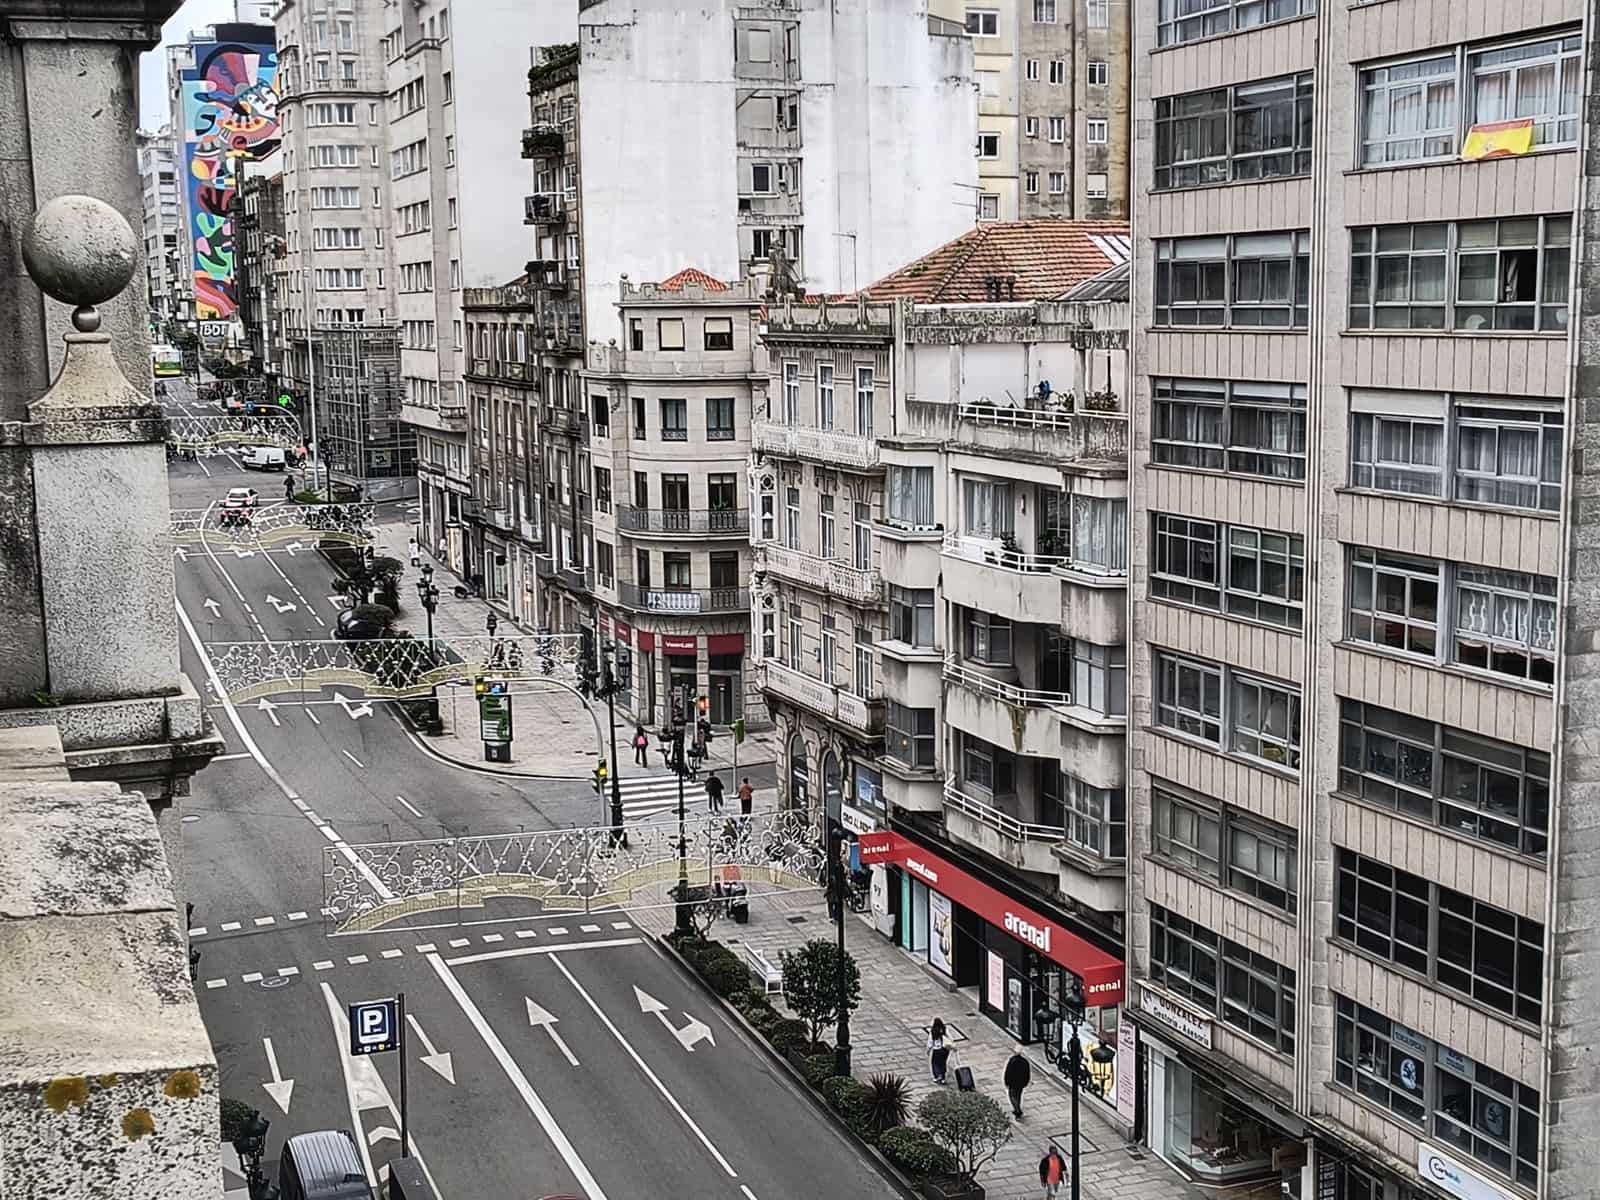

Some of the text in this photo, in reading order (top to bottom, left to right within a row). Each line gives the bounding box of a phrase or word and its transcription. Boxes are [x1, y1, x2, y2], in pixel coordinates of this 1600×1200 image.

[863, 843, 890, 855] arenal
[1004, 912, 1051, 952] arenal
[1089, 979, 1121, 993] arenal
[363, 1010, 382, 1033] P
